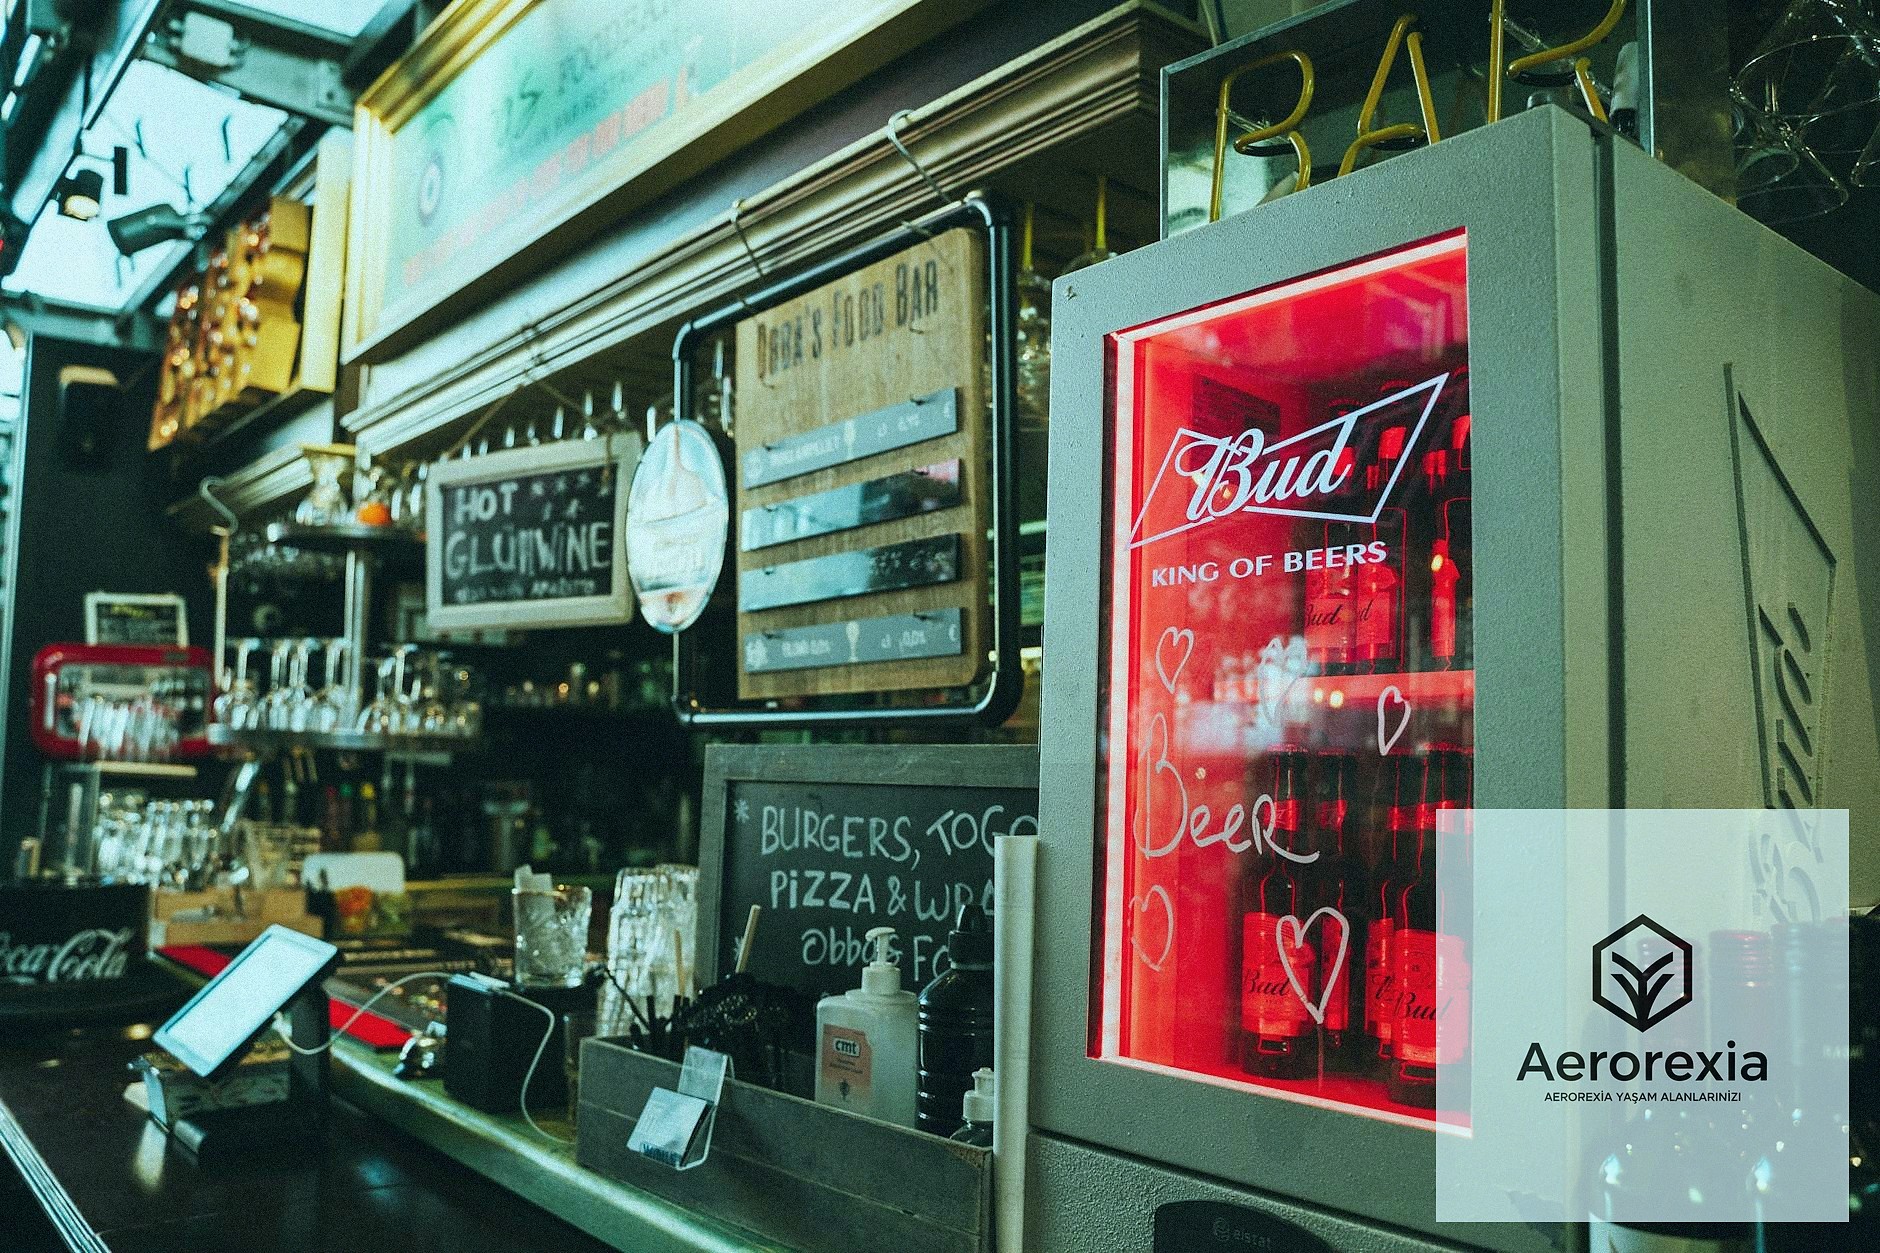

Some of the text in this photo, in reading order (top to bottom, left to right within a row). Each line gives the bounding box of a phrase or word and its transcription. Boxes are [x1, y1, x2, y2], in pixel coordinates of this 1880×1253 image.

[895, 260, 938, 326] BAR
[1174, 416, 1359, 522] Bud
[454, 482, 518, 525] HOT
[1152, 540, 1387, 588] KING OF BEERS
[761, 805, 920, 870] BURGERS,
[887, 875, 907, 916] &
[835, 1039, 857, 1055] cmt
